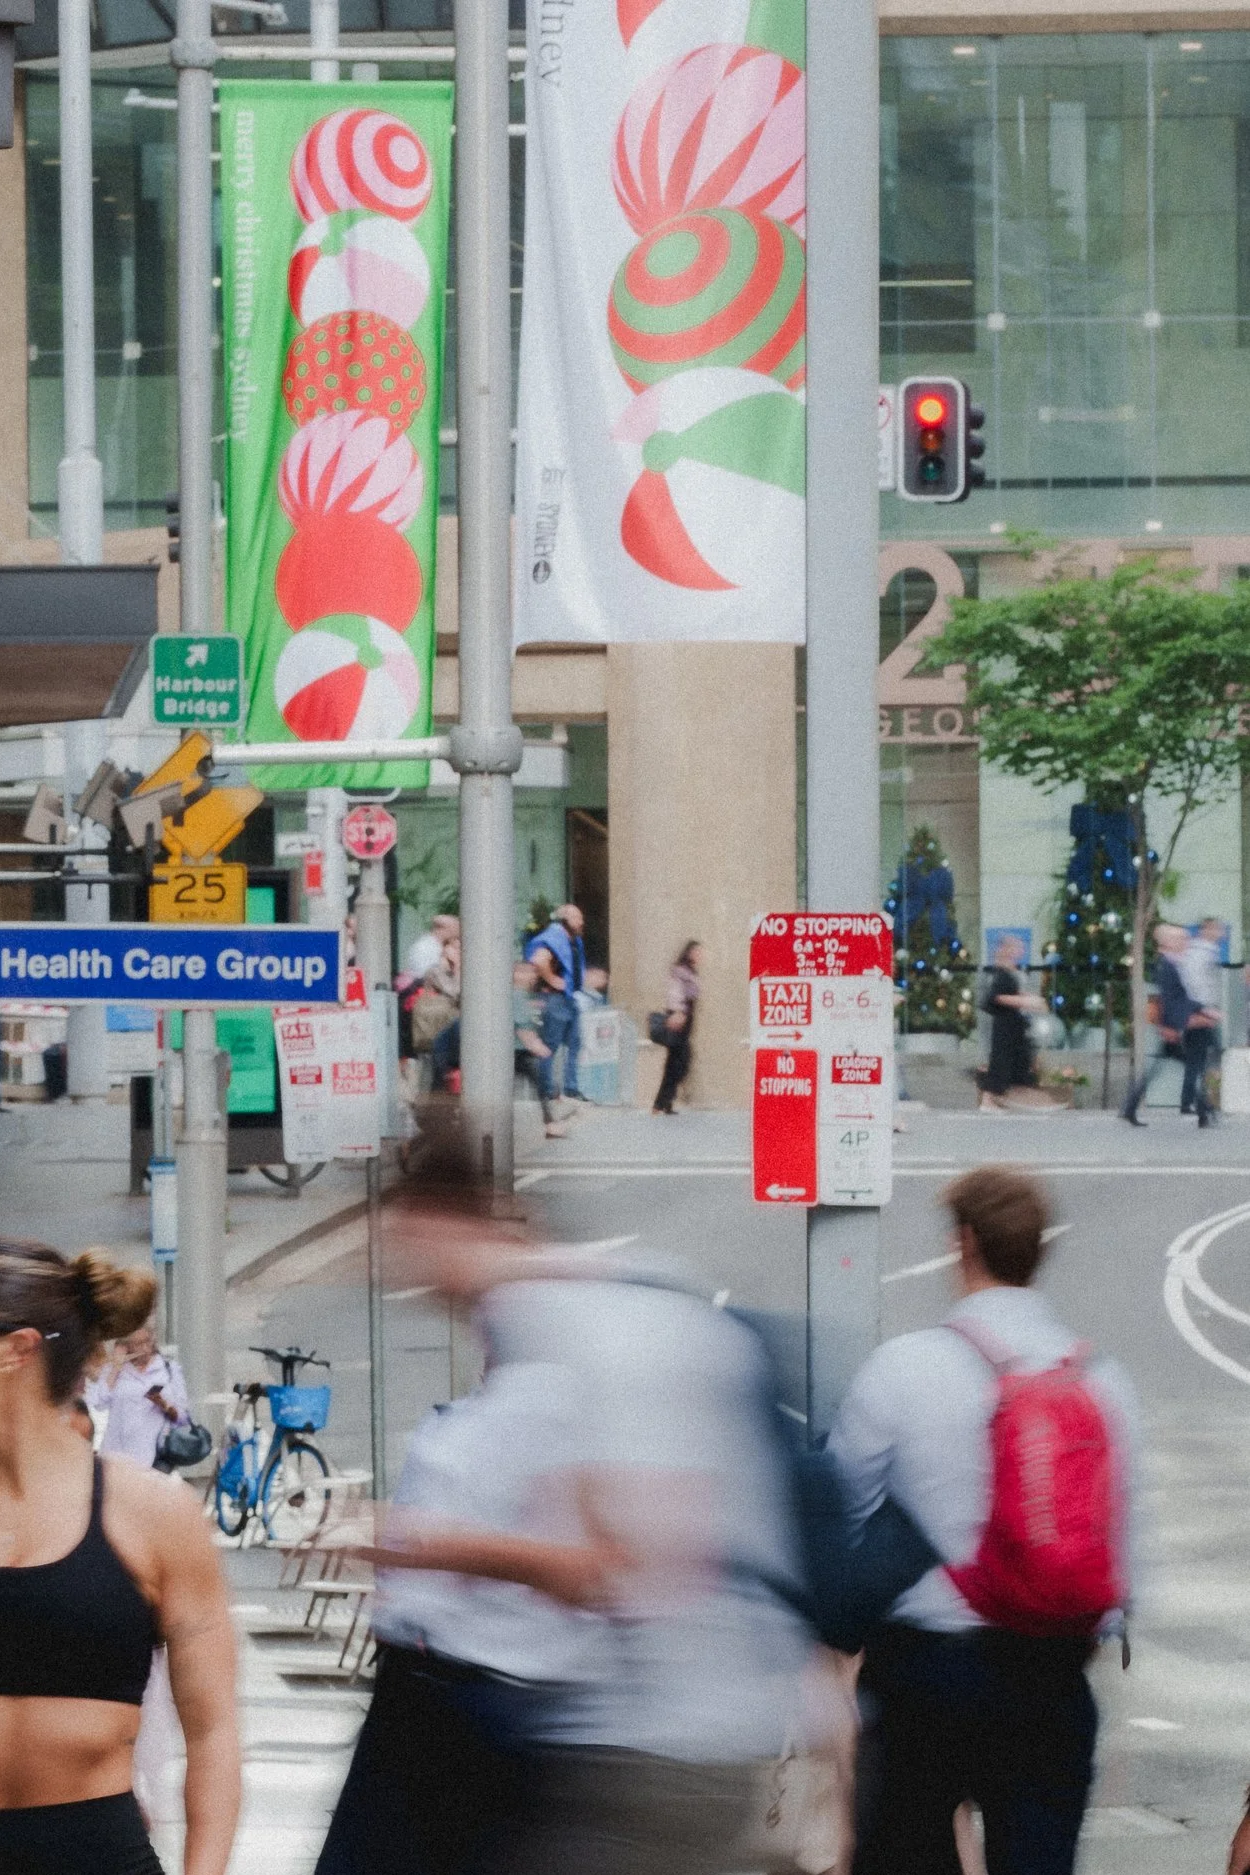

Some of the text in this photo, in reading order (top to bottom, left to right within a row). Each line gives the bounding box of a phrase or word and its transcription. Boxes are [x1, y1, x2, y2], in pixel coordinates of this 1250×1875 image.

[228, 110, 261, 441] merry christmas sydney
[533, 502, 560, 558] SYDNEY
[156, 675, 237, 693] Harbour
[163, 698, 230, 719] Bridge
[347, 821, 393, 842] STOP
[174, 873, 226, 903] 25
[760, 917, 883, 936] NO STOPPING
[0, 948, 112, 979] Health
[122, 948, 206, 980] Care
[216, 948, 326, 988] Group
[763, 984, 809, 1004] TAXI
[763, 1005, 808, 1024] ZONE
[776, 1056, 796, 1074] NO
[835, 1058, 878, 1070] LOADING
[841, 1070, 872, 1082] ZONE
[759, 1077, 812, 1096] STOPPING
[840, 1130, 870, 1146] 4P
